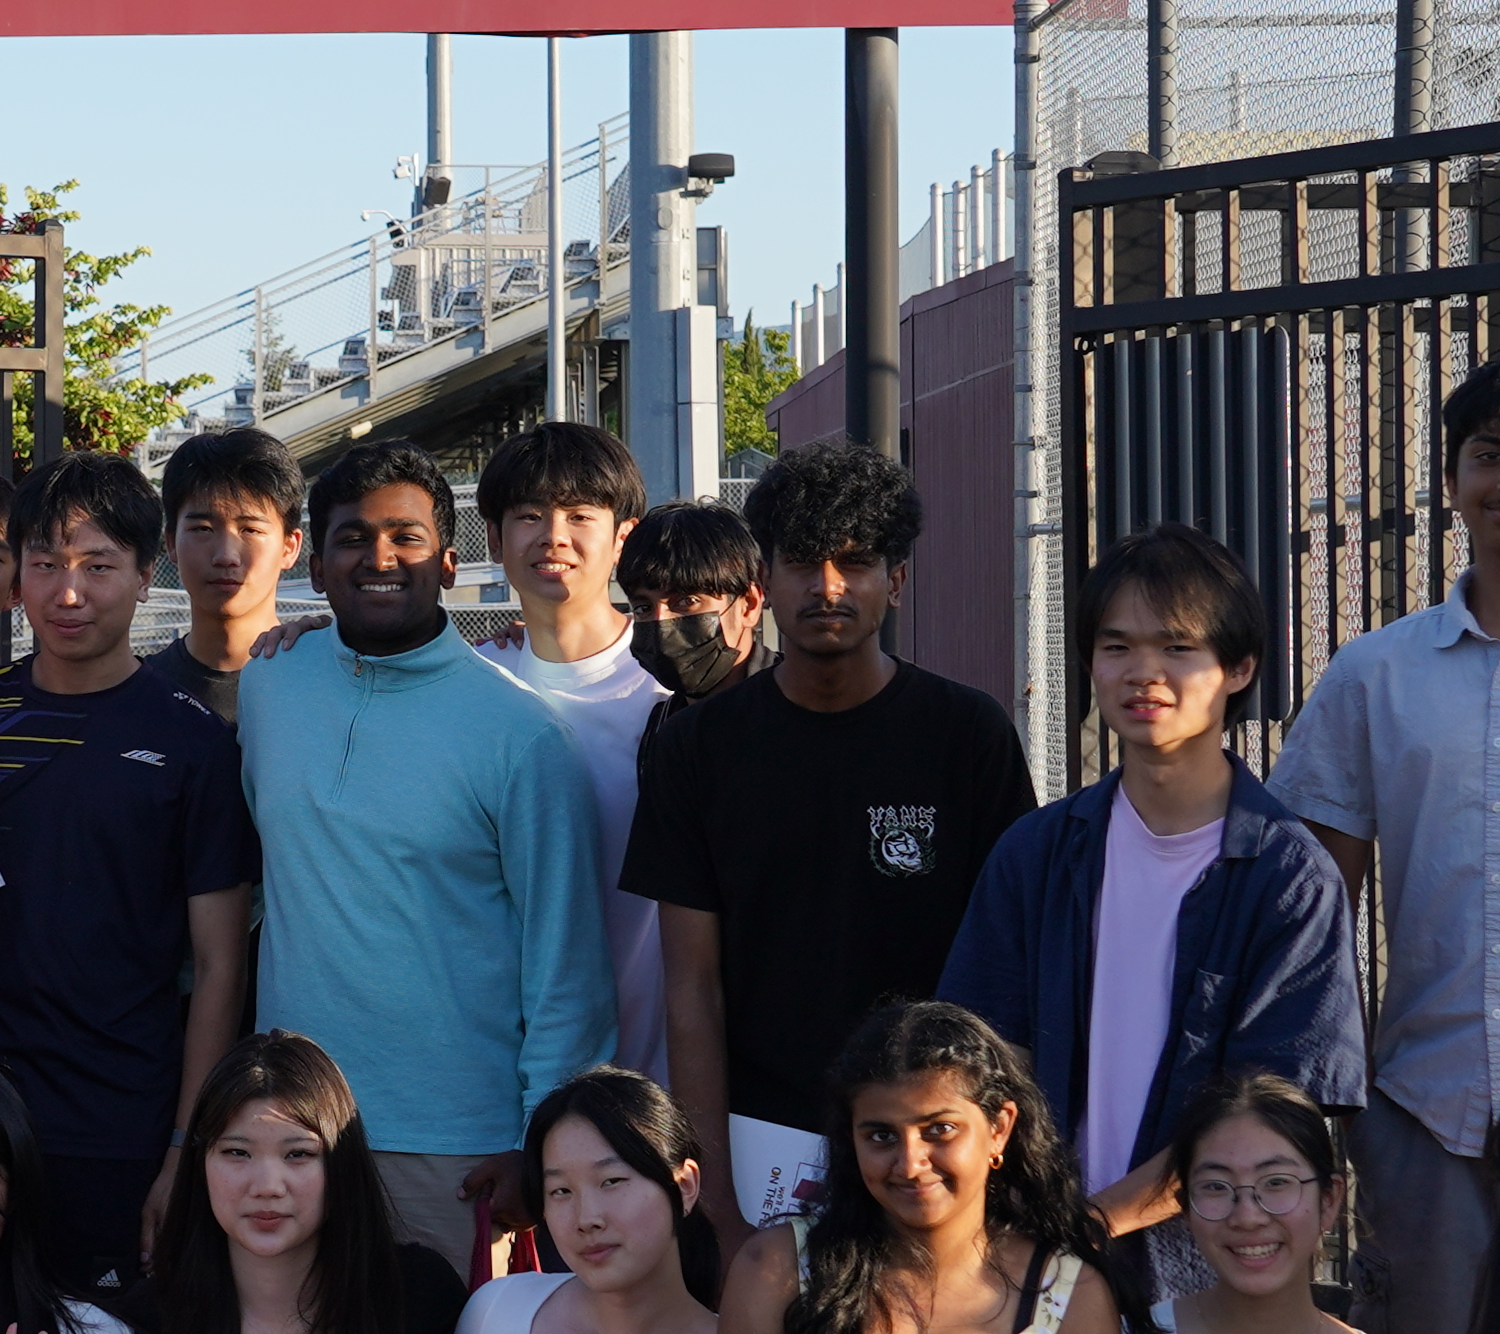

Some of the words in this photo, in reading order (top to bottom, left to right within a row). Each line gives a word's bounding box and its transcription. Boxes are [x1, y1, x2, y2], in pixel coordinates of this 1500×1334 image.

[867, 805, 937, 839] VANS
[768, 1166, 782, 1185] ON
[762, 1188, 777, 1210] THE
